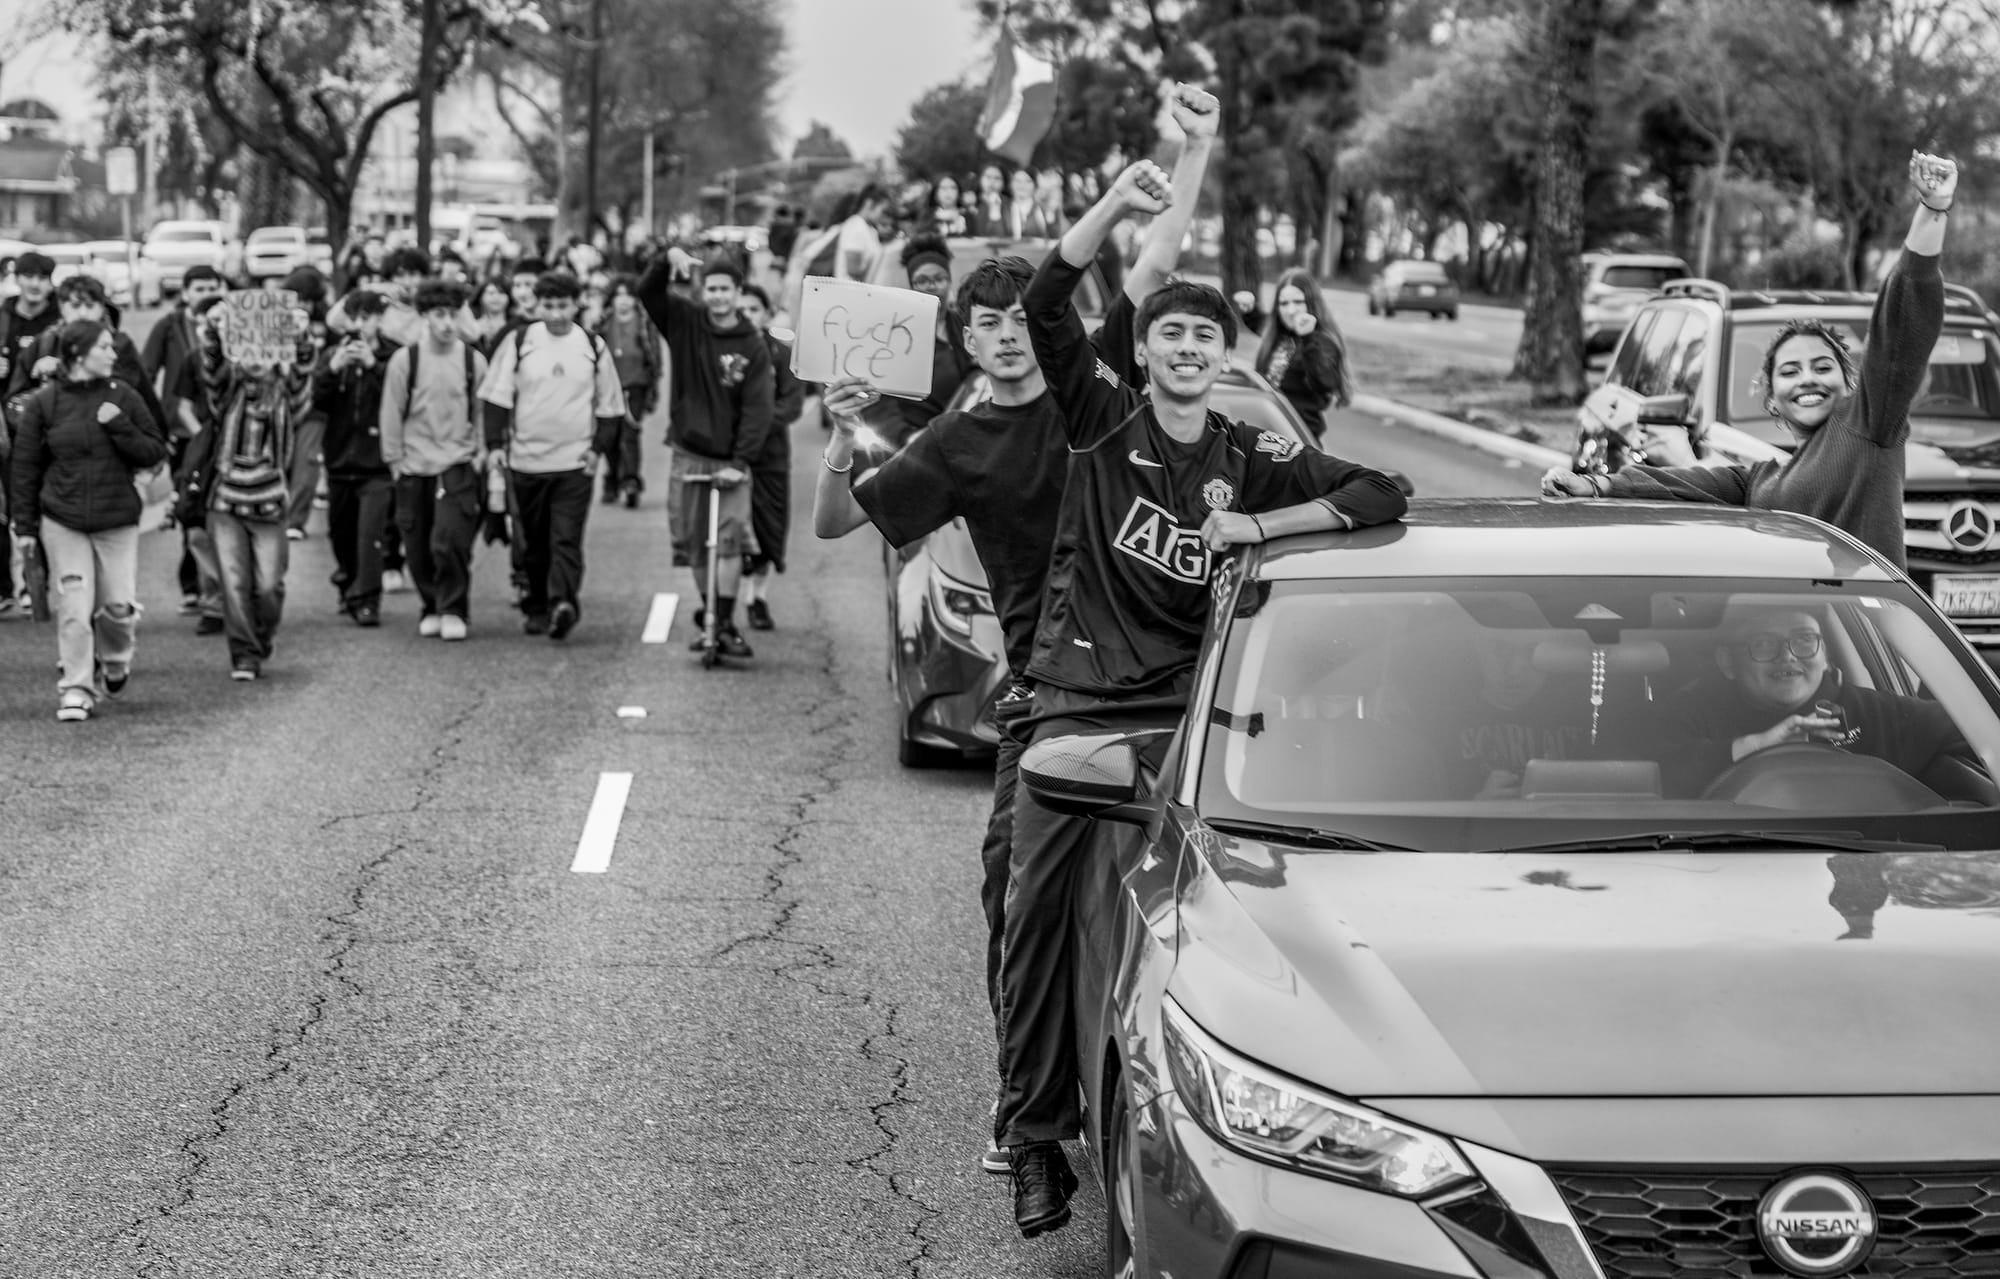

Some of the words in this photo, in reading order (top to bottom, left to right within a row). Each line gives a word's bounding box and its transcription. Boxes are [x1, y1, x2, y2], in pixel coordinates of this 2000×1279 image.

[1122, 512, 1204, 578] AIG
[1940, 591, 2000, 610] 7KRZ75
[1775, 1218, 1860, 1233] NISSAN
